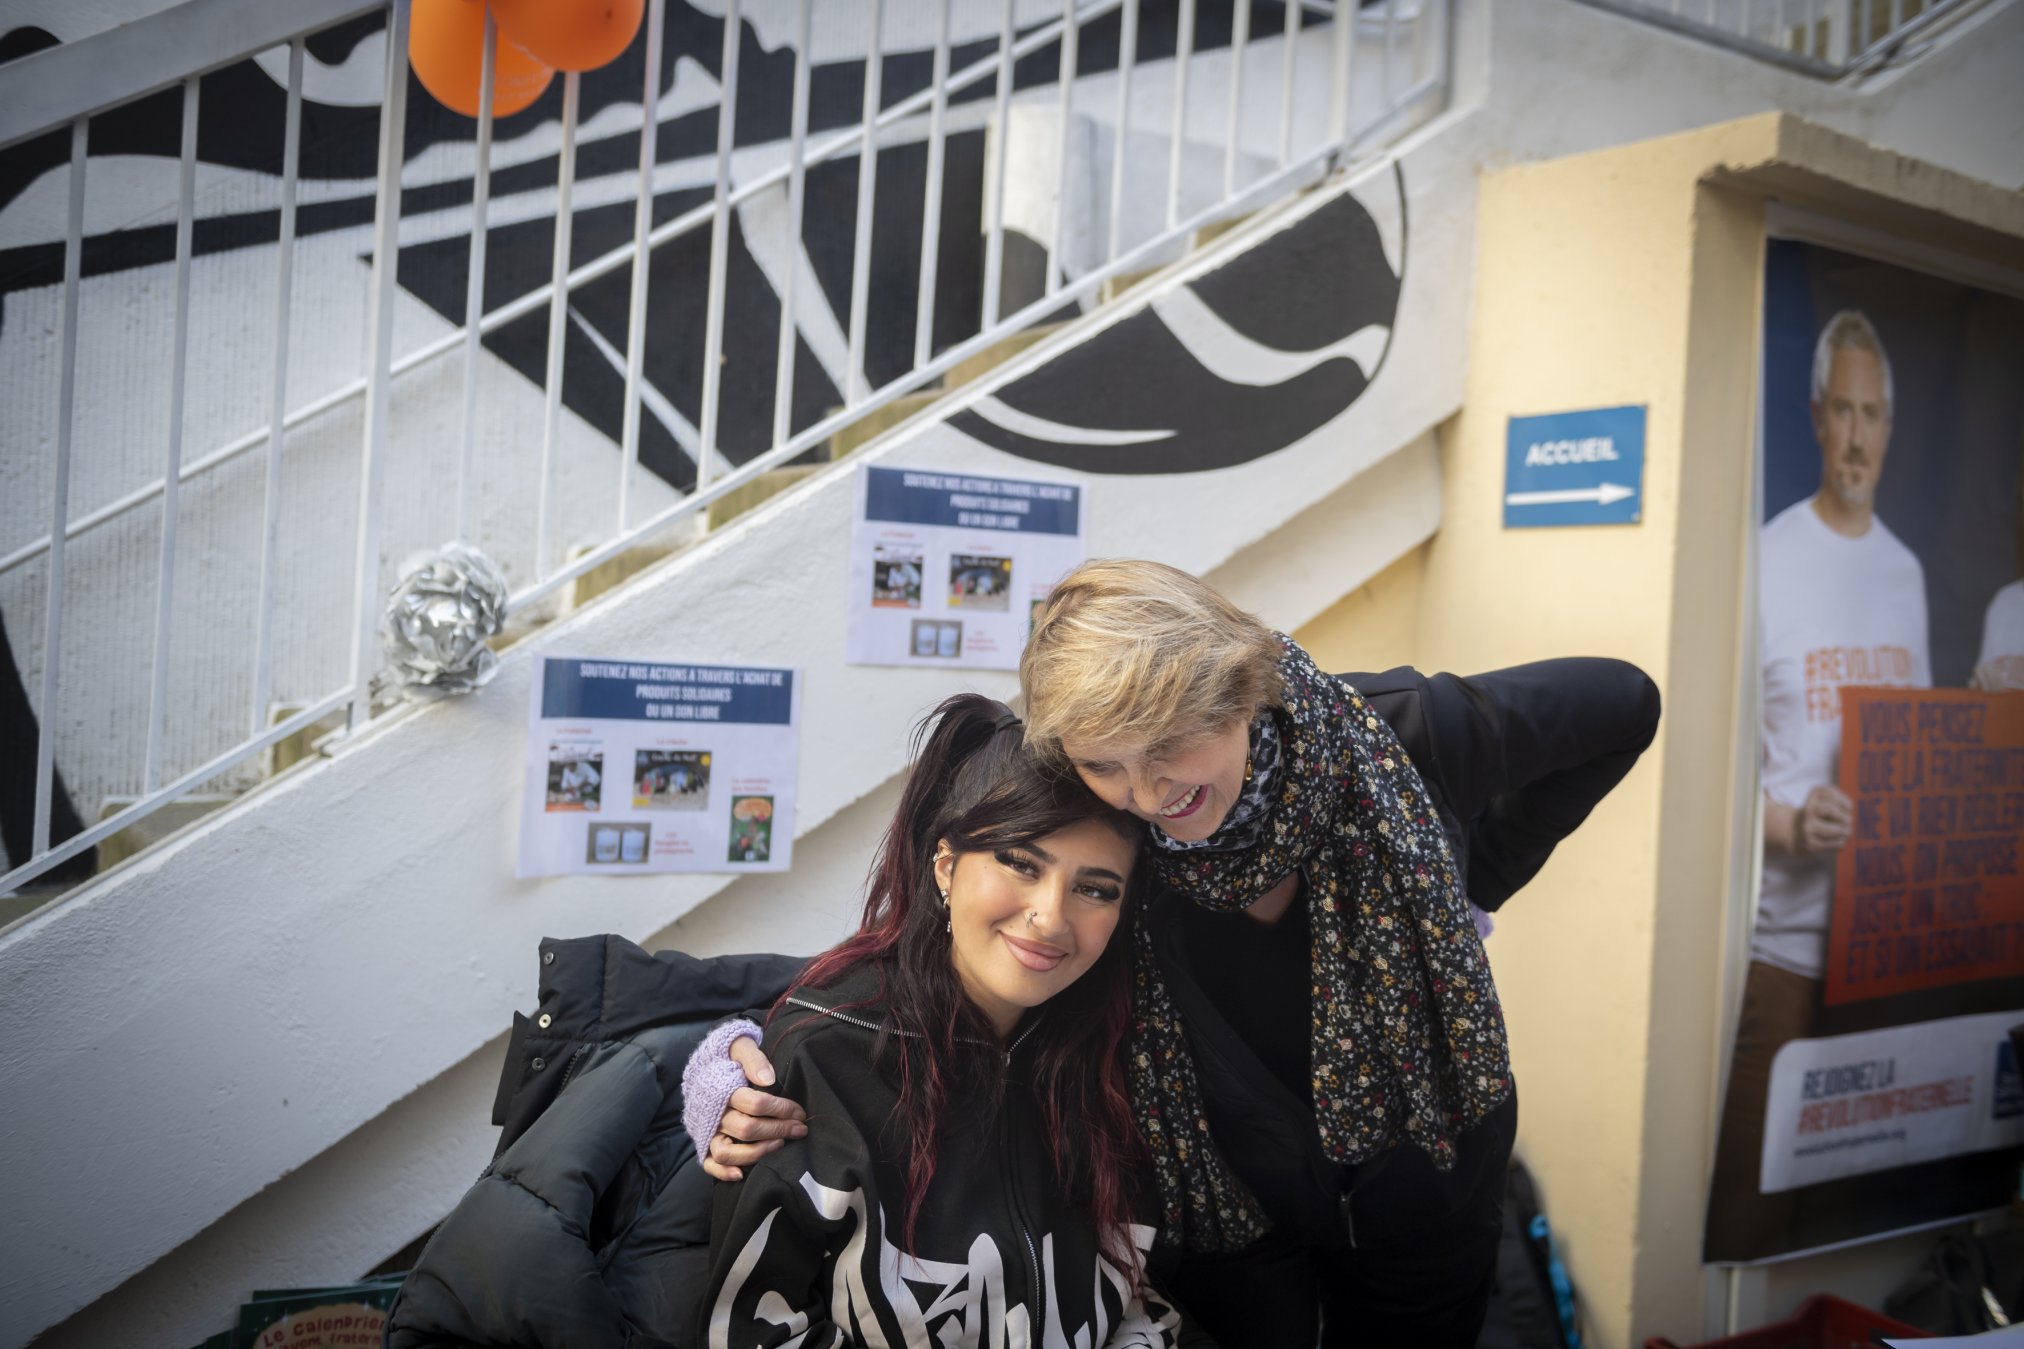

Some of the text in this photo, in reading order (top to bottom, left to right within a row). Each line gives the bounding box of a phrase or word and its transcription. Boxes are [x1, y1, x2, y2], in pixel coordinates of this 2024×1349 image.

[1525, 437, 1619, 467] ACCUEIL
[579, 663, 628, 680] SOUTENEZ
[629, 667, 647, 680] NOS
[649, 667, 688, 682] ACTIONS
[697, 669, 735, 684] TRAVERS
[735, 671, 770, 686] L'ACHAT
[771, 672, 783, 687] DE
[635, 684, 732, 703] PRODUITS SOLIDAIRES
[645, 703, 720, 720] OU UN DON LIBRE
[1859, 702, 1911, 744] VOUS
[1916, 702, 1987, 744] PENSEZ
[1858, 750, 1896, 793] QUE
[1899, 749, 1925, 792] LA
[1856, 796, 1882, 841] NE
[1887, 796, 1912, 840] VA
[1918, 795, 1957, 836] RIEN
[1912, 841, 1938, 884] ON
[1942, 834, 2019, 879] PROPOSE
[1852, 890, 1905, 934] JUSTE
[1908, 887, 1935, 928] UN
[1846, 940, 1871, 984] ET
[1873, 938, 1891, 977] SI
[1893, 934, 1922, 977] ON
[1803, 1058, 1894, 1099] REJOIGNEZ LA
[264, 1330, 284, 1347] Le
[330, 1332, 381, 1344] fratern
